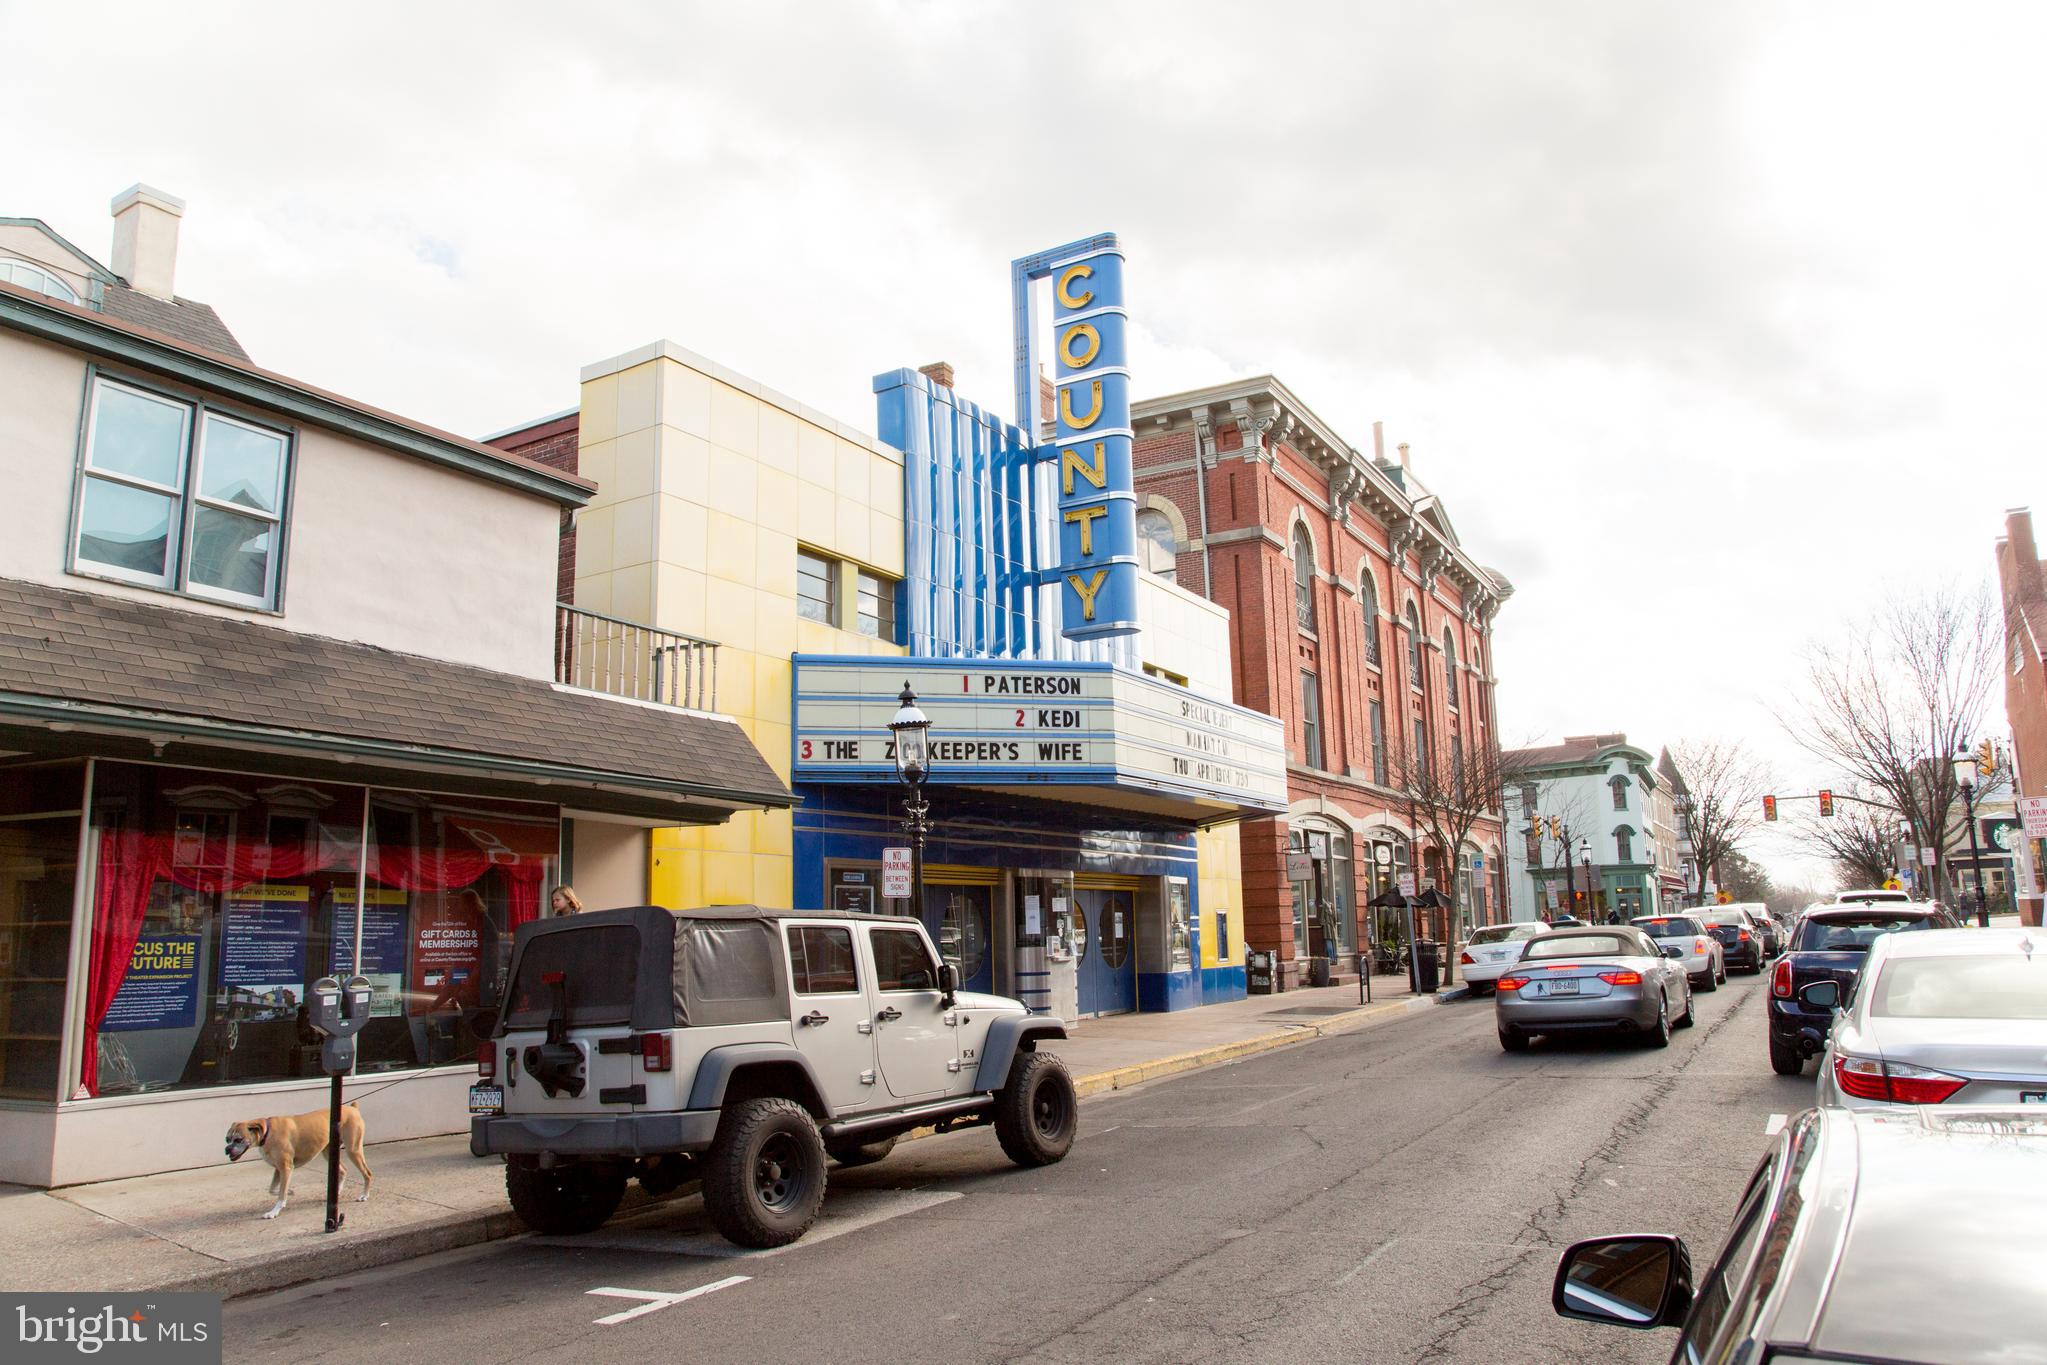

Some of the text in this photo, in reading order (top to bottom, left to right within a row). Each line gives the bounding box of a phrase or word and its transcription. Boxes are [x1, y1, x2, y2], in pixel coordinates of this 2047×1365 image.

[1056, 264, 1110, 621] COUNTY
[984, 675, 1081, 695] PATERSON
[1015, 709, 1081, 728] 2 KEDI
[1182, 700, 1211, 724] SPECIAL
[801, 740, 813, 759] 3
[823, 741, 858, 760] THE
[1038, 743, 1082, 761] WIFE
[1173, 757, 1189, 776] THU
[2023, 809, 2047, 817] PARKIN
[892, 851, 902, 860] NO
[884, 862, 910, 871] PARKING
[421, 930, 478, 939] GIFT CARDS &
[166, 942, 195, 955] THE
[419, 939, 478, 949] MEMBERSHIPS
[130, 956, 181, 970] UTURE
